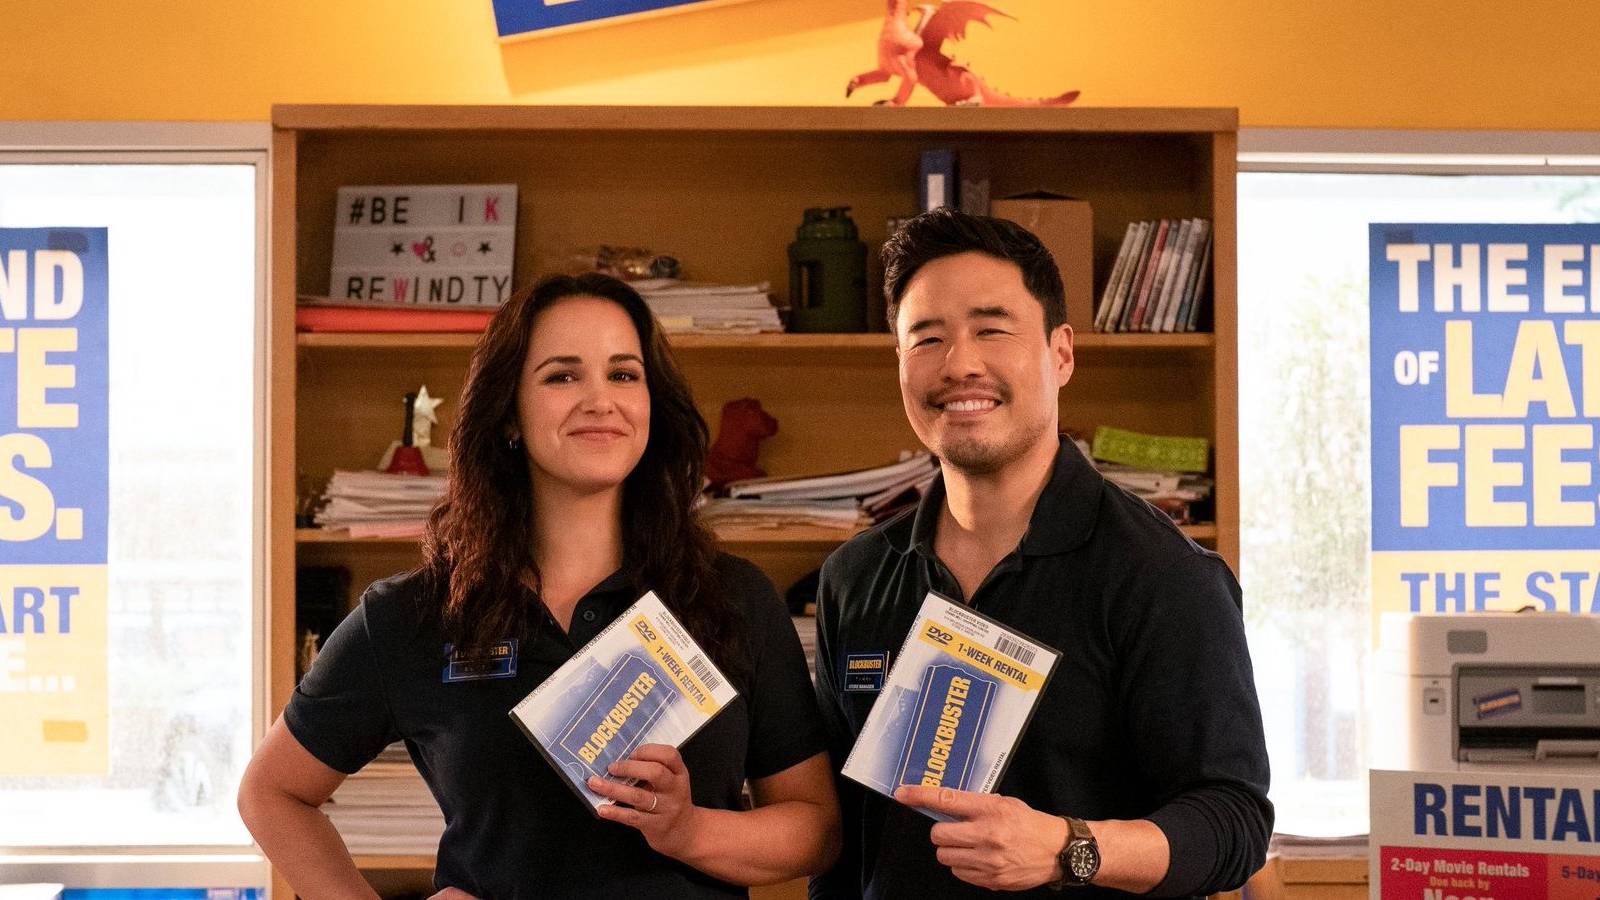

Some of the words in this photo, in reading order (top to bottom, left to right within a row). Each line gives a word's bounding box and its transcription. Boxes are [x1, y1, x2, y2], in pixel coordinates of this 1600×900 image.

[350, 196, 410, 224] #BE
[484, 197, 499, 222] K
[1386, 243, 1530, 313] THE
[1544, 244, 1600, 313] E
[0, 327, 79, 428] E
[1394, 350, 1440, 385] OF
[1400, 424, 1600, 528] FEE
[0, 586, 80, 634] RT
[1526, 571, 1600, 614] ST
[637, 620, 657, 641] DVD
[928, 626, 953, 641] DVD
[655, 646, 684, 678] 1-WEEK
[680, 675, 707, 706] RENTAL
[958, 642, 994, 667] 1-WEEK
[994, 660, 1028, 684] RENTAL
[578, 672, 657, 764] BLOCKBUSTER
[921, 676, 971, 787] BLOCKBUSTER
[1413, 783, 1600, 843] RENTA
[1391, 858, 1430, 875] 2-Day
[1434, 859, 1474, 874] Movie
[1478, 861, 1530, 878] Rentals
[1478, 878, 1490, 890] by
